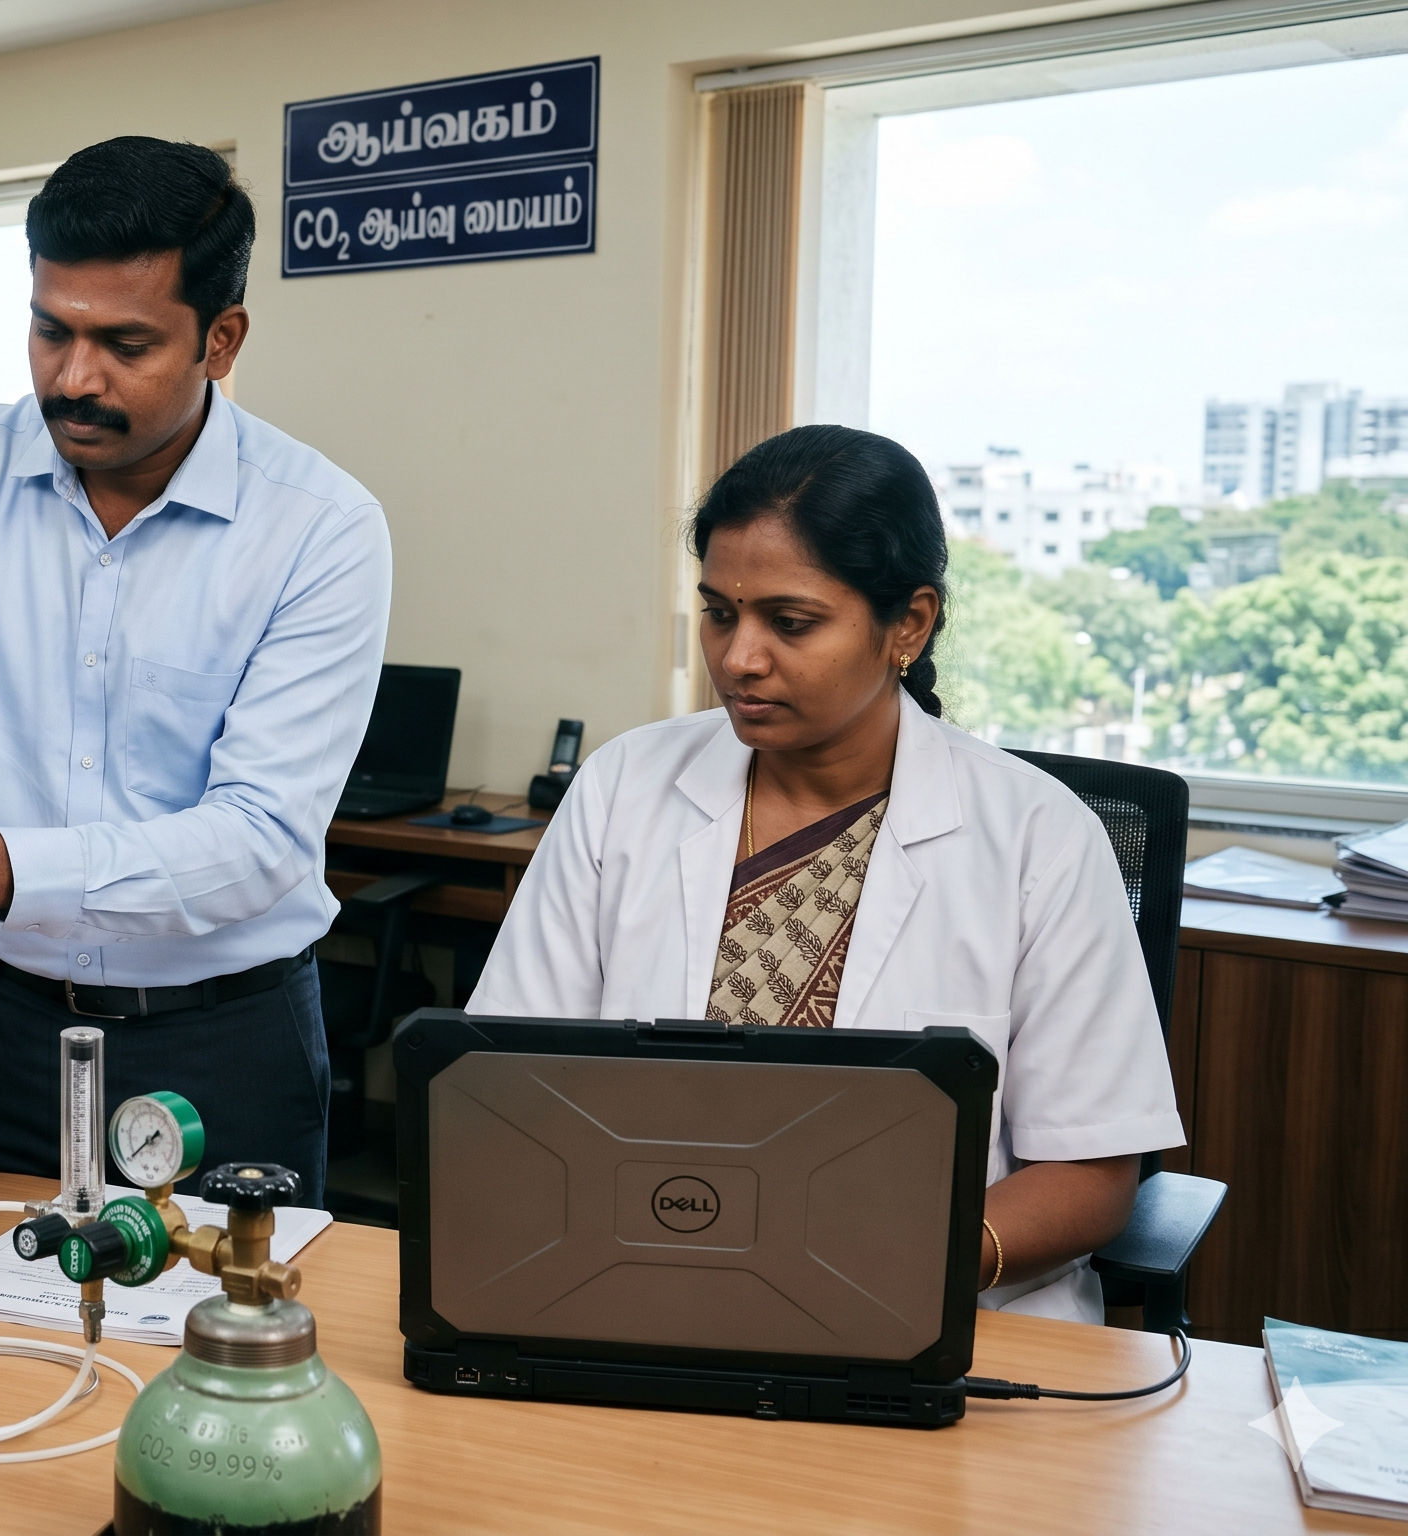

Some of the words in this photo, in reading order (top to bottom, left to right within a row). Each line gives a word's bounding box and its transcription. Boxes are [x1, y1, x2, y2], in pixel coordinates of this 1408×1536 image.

[317, 81, 557, 167] ஆய்வகம்
[293, 207, 350, 260] CO₂
[358, 191, 456, 250] ஆய்வு
[464, 175, 583, 235] மையம்
[659, 1197, 714, 1212] DELL
[139, 1434, 174, 1467] CO2
[188, 1449, 282, 1481] 99.99%
